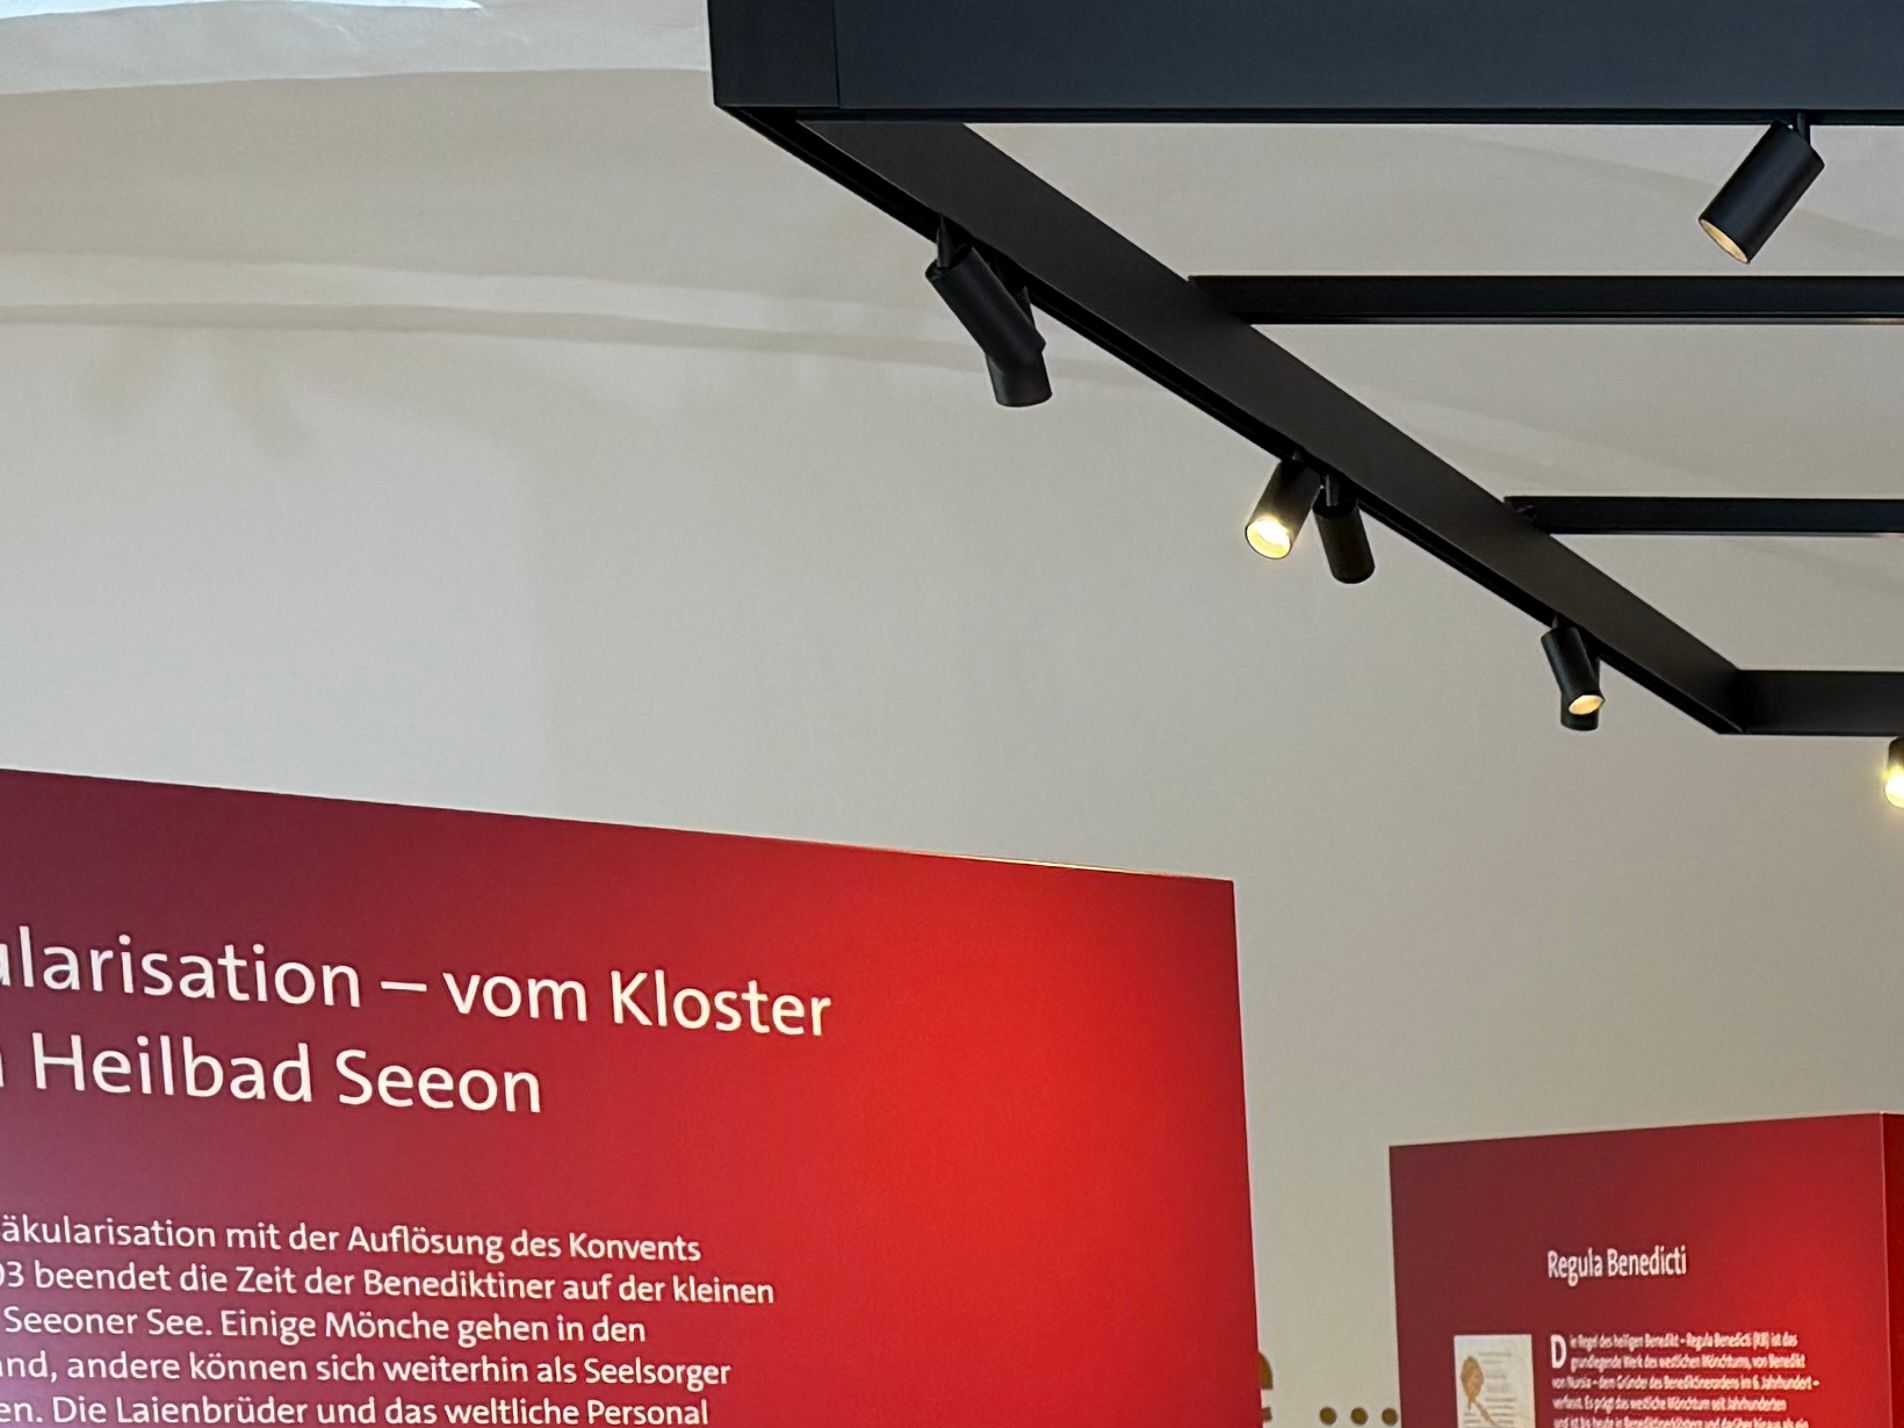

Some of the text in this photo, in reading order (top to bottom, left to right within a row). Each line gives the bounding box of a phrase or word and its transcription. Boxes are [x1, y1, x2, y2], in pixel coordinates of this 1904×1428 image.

[443, 973, 586, 1021] vom
[611, 970, 831, 1035] Kloster
[33, 1033, 540, 1112] Heilbad Seeon
[227, 1223, 700, 1263] mit der Auflösung des Konvents
[1548, 1245, 1686, 1286] Regula Benedicti
